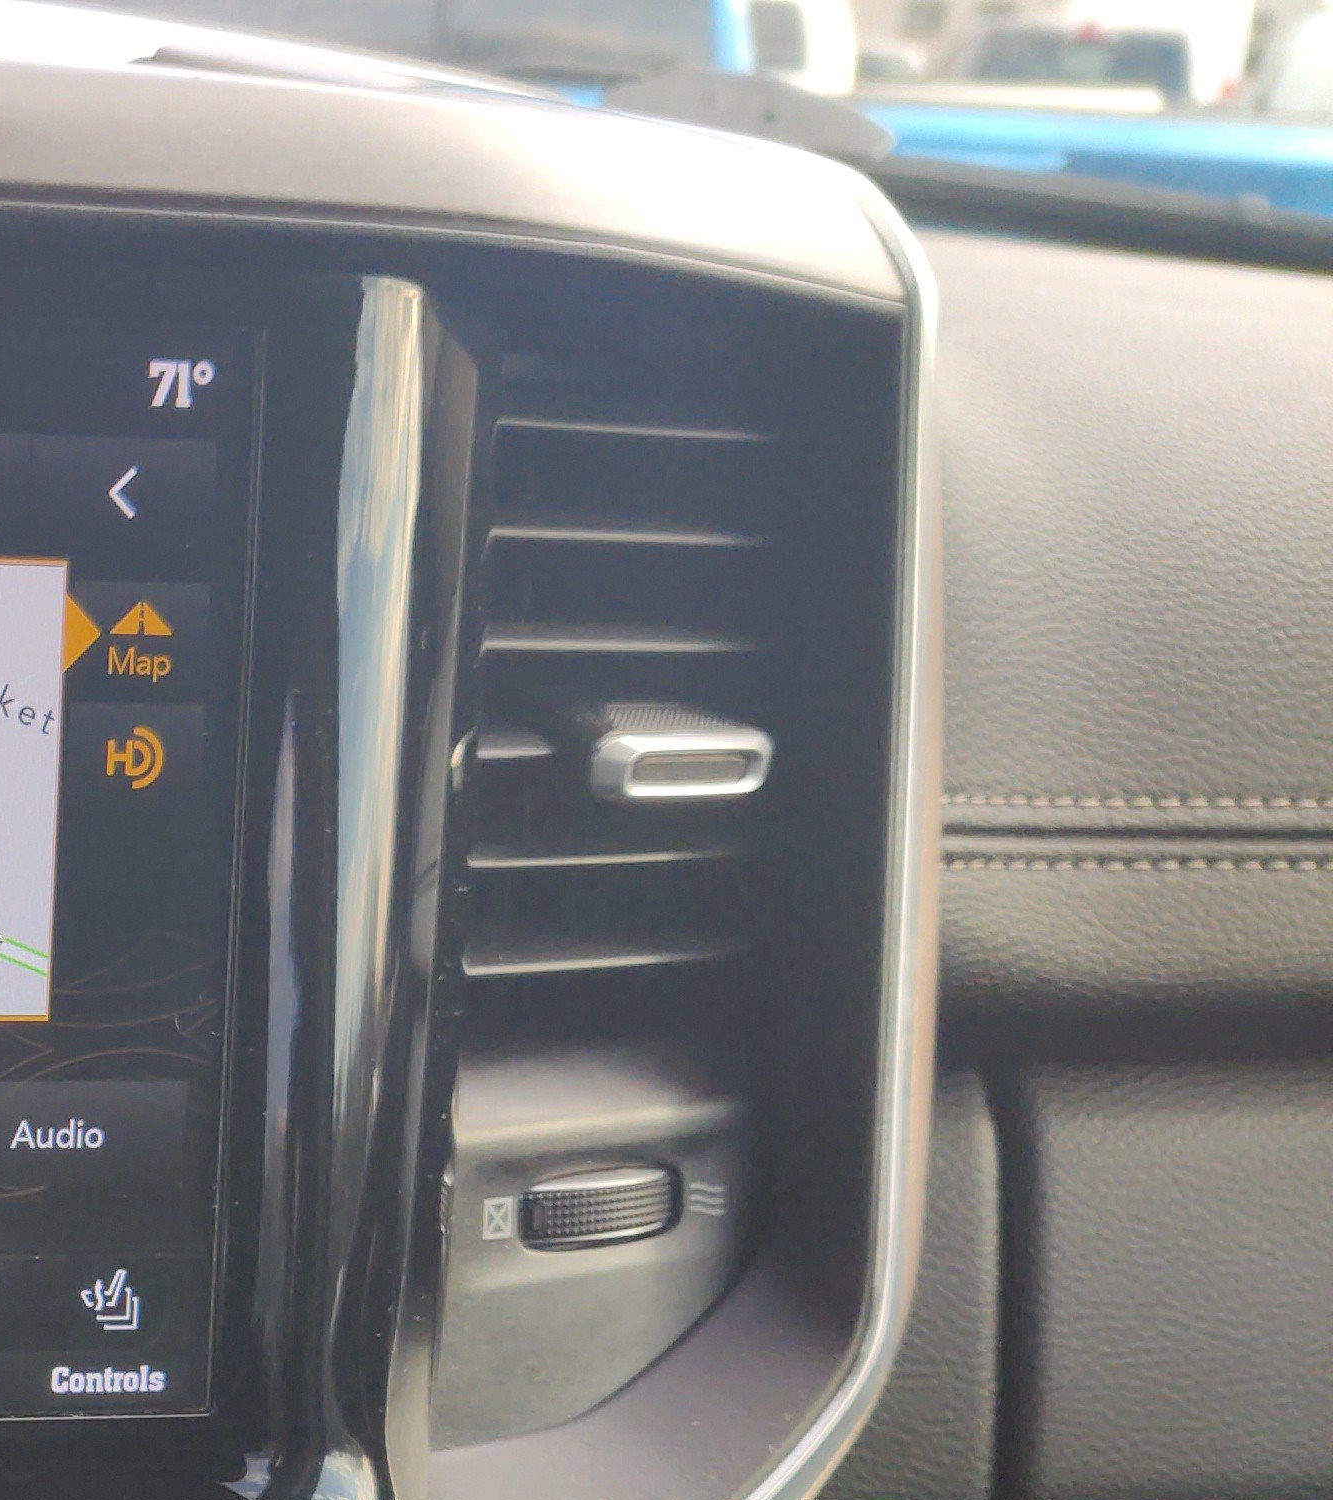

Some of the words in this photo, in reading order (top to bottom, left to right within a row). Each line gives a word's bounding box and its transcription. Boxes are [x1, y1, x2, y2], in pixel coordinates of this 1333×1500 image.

[148, 359, 214, 408] 71°
[107, 646, 172, 682] Map
[9, 1119, 104, 1150] Audio
[51, 1365, 166, 1394] Controls
